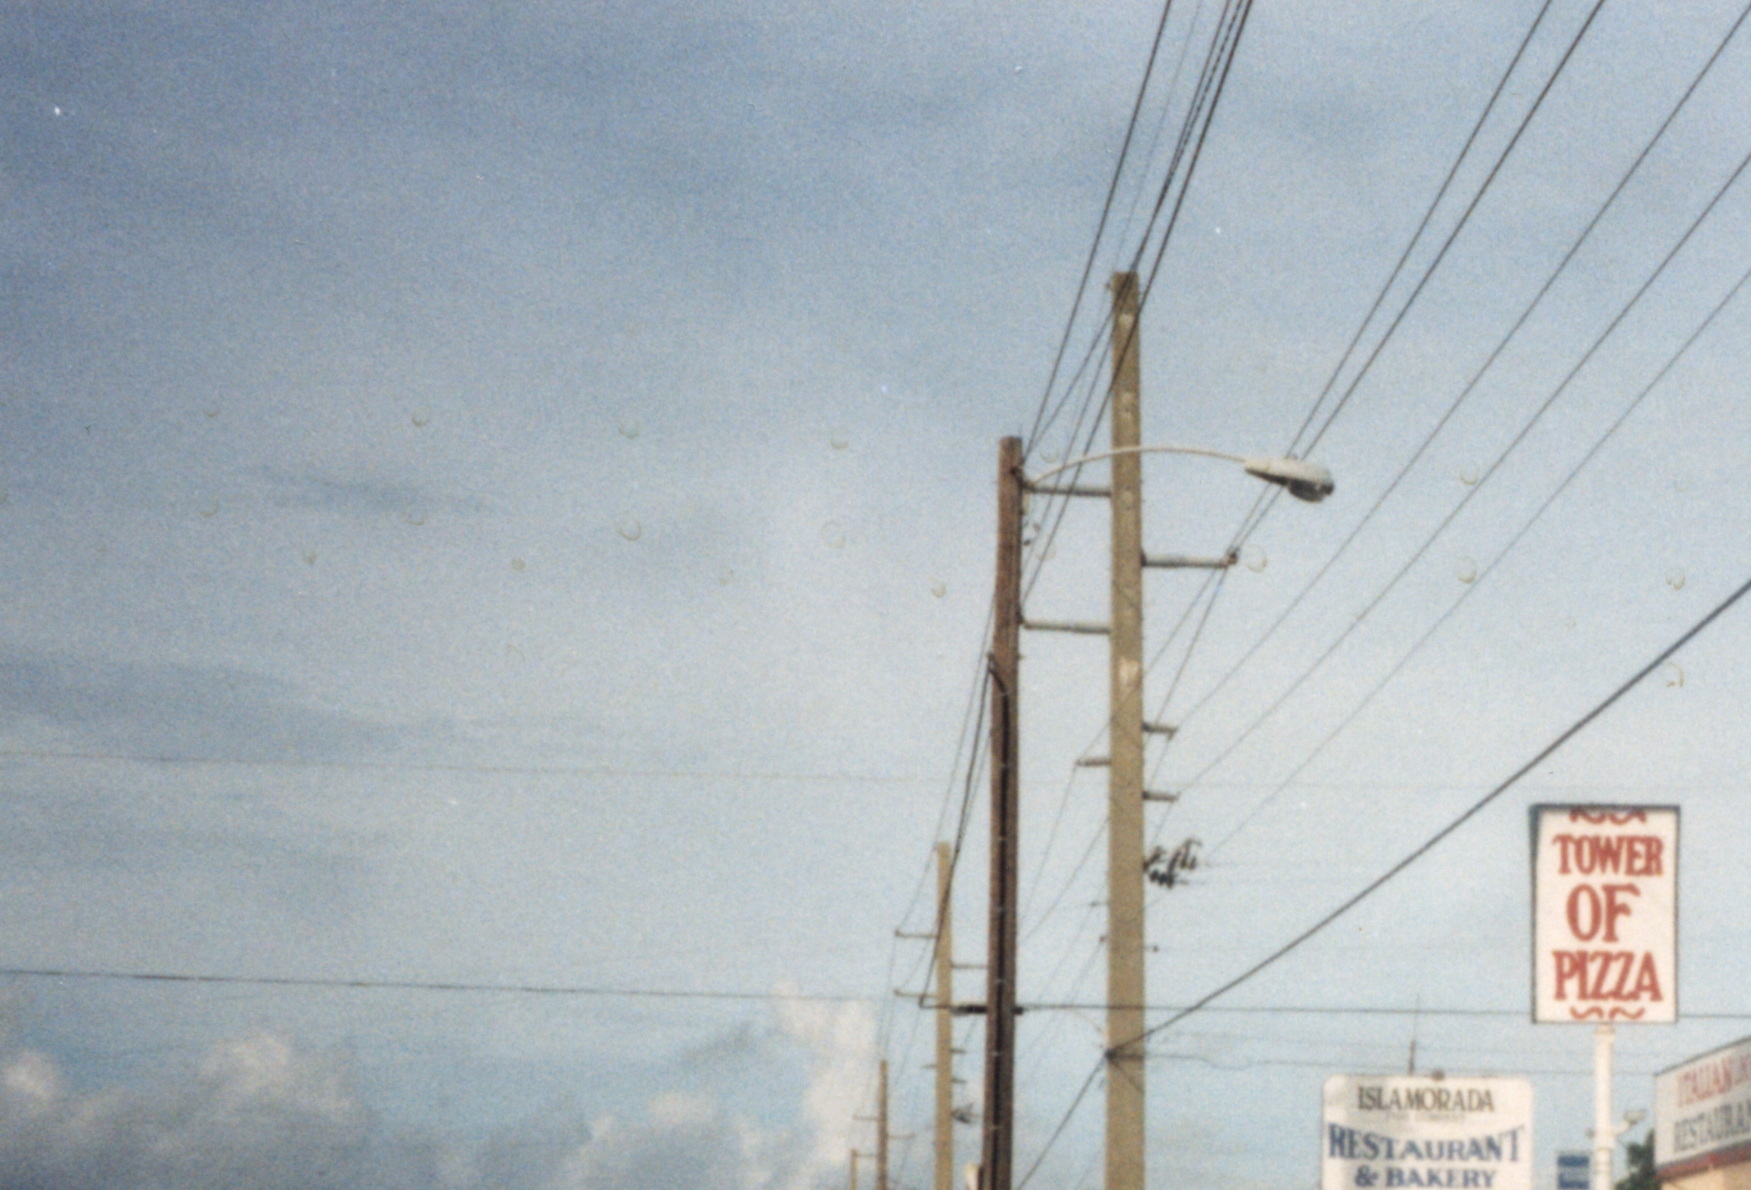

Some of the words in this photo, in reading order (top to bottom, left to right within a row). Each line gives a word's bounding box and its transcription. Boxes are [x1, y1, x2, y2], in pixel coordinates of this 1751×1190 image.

[1552, 834, 1664, 876] TOWER
[1566, 883, 1641, 943] OF
[1552, 950, 1663, 1001] PIZZA
[1357, 1086, 1495, 1112] ISLAMORADA
[1327, 1123, 1525, 1163] RESTAURANT
[1354, 1165, 1378, 1187] &
[1385, 1167, 1497, 1189] BAKERY
